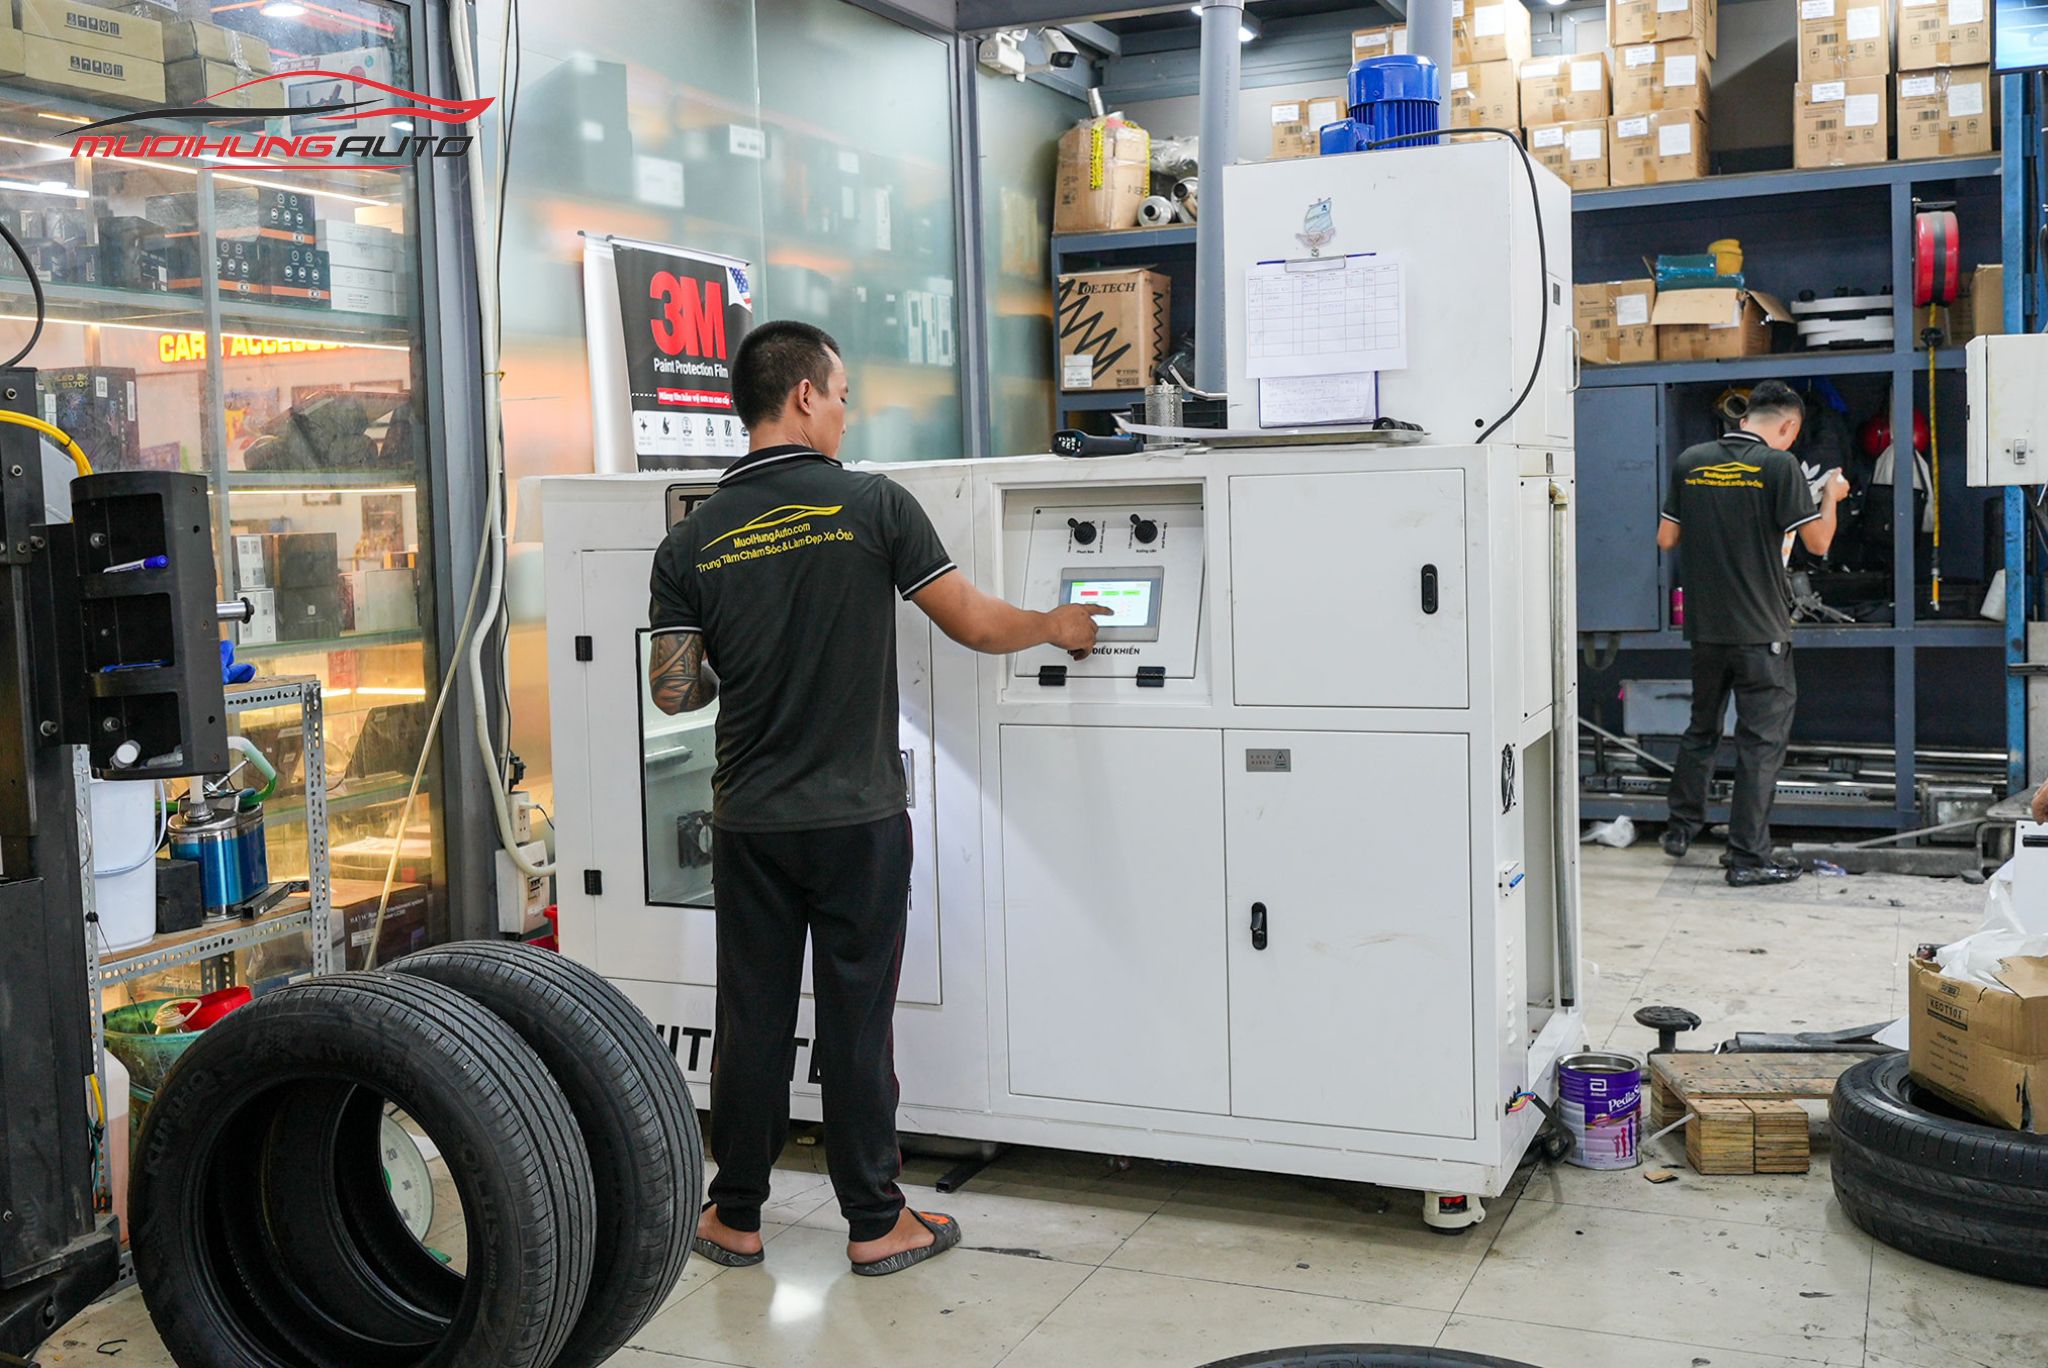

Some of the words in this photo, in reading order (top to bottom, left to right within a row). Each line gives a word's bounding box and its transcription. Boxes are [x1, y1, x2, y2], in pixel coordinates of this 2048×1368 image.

[649, 270, 727, 360] 3M
[159, 333, 224, 363] CAR
[653, 357, 675, 374] Paint
[675, 360, 714, 377] Protection
[714, 363, 729, 379] Film
[696, 558, 722, 573] Trung
[823, 531, 836, 542] Xe
